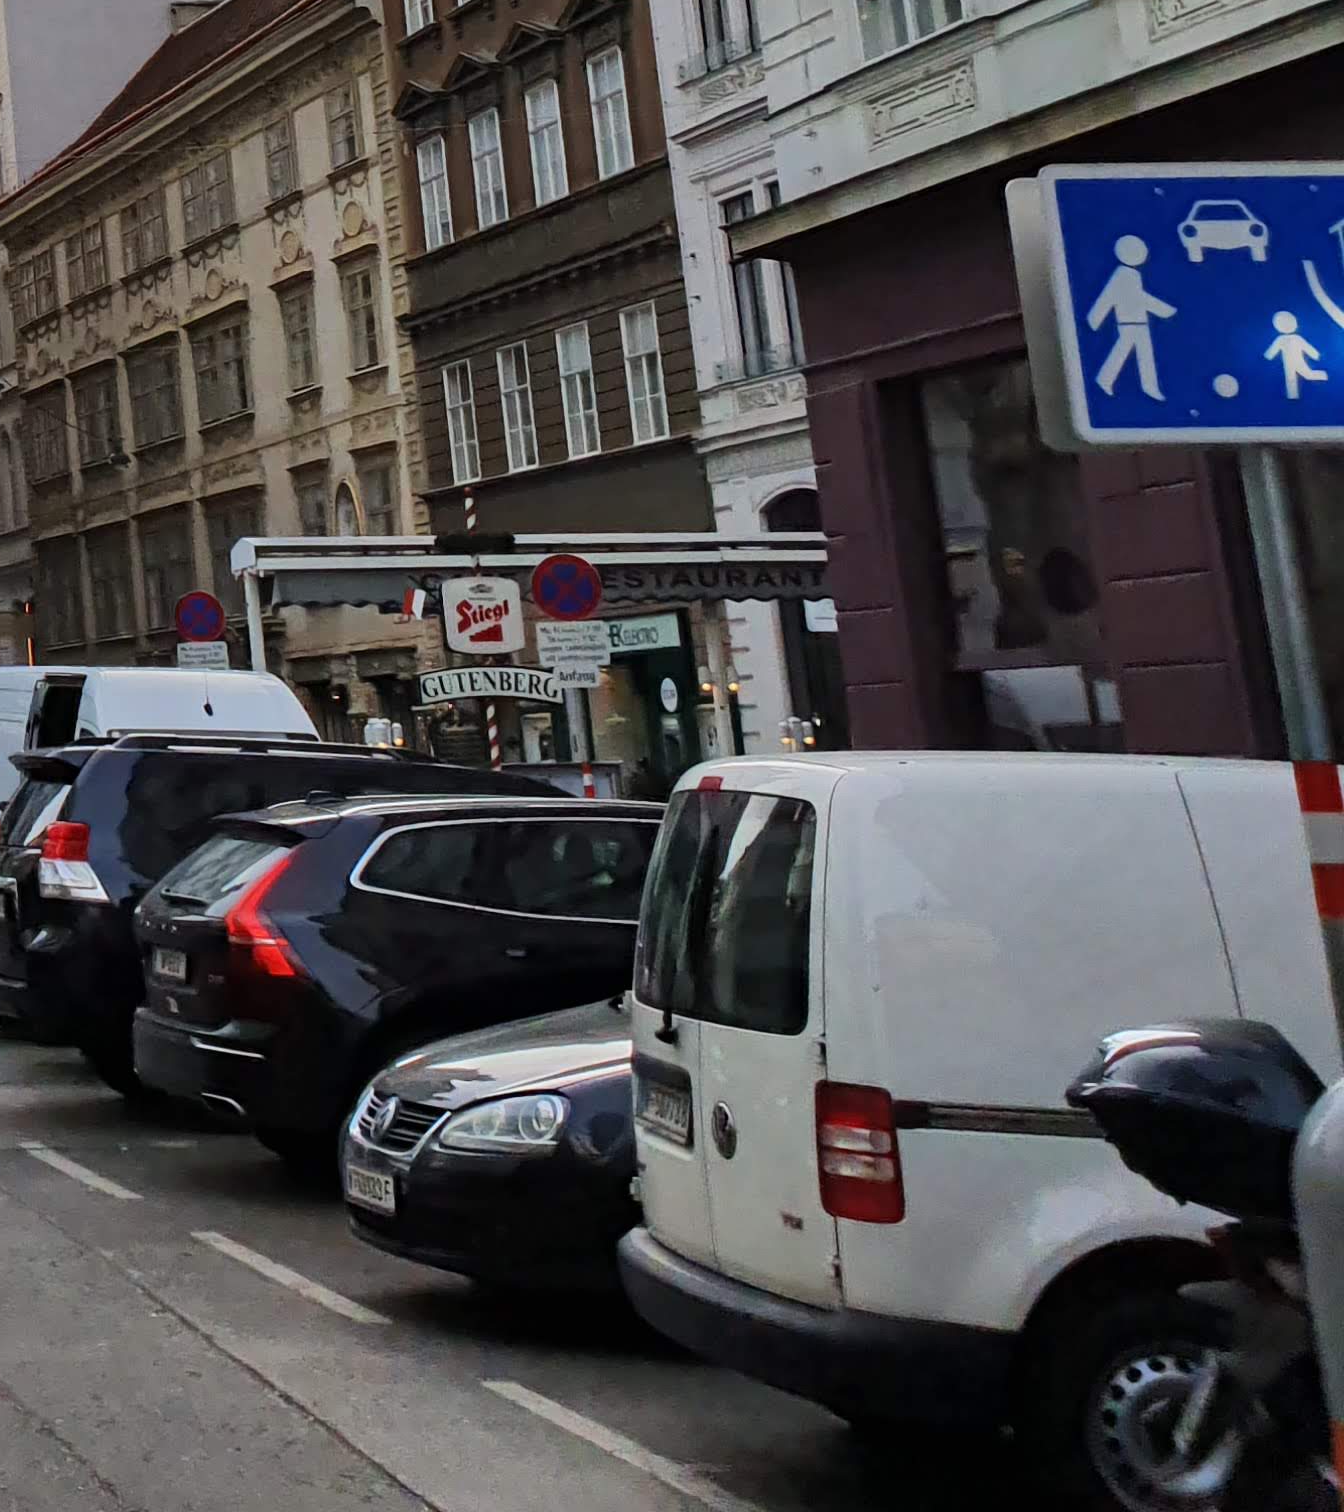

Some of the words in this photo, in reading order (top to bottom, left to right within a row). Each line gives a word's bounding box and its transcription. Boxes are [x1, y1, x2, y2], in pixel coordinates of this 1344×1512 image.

[602, 566, 822, 590] ESTAURANT
[456, 599, 510, 634] Stiegl
[421, 670, 558, 699] GUTENBERG
